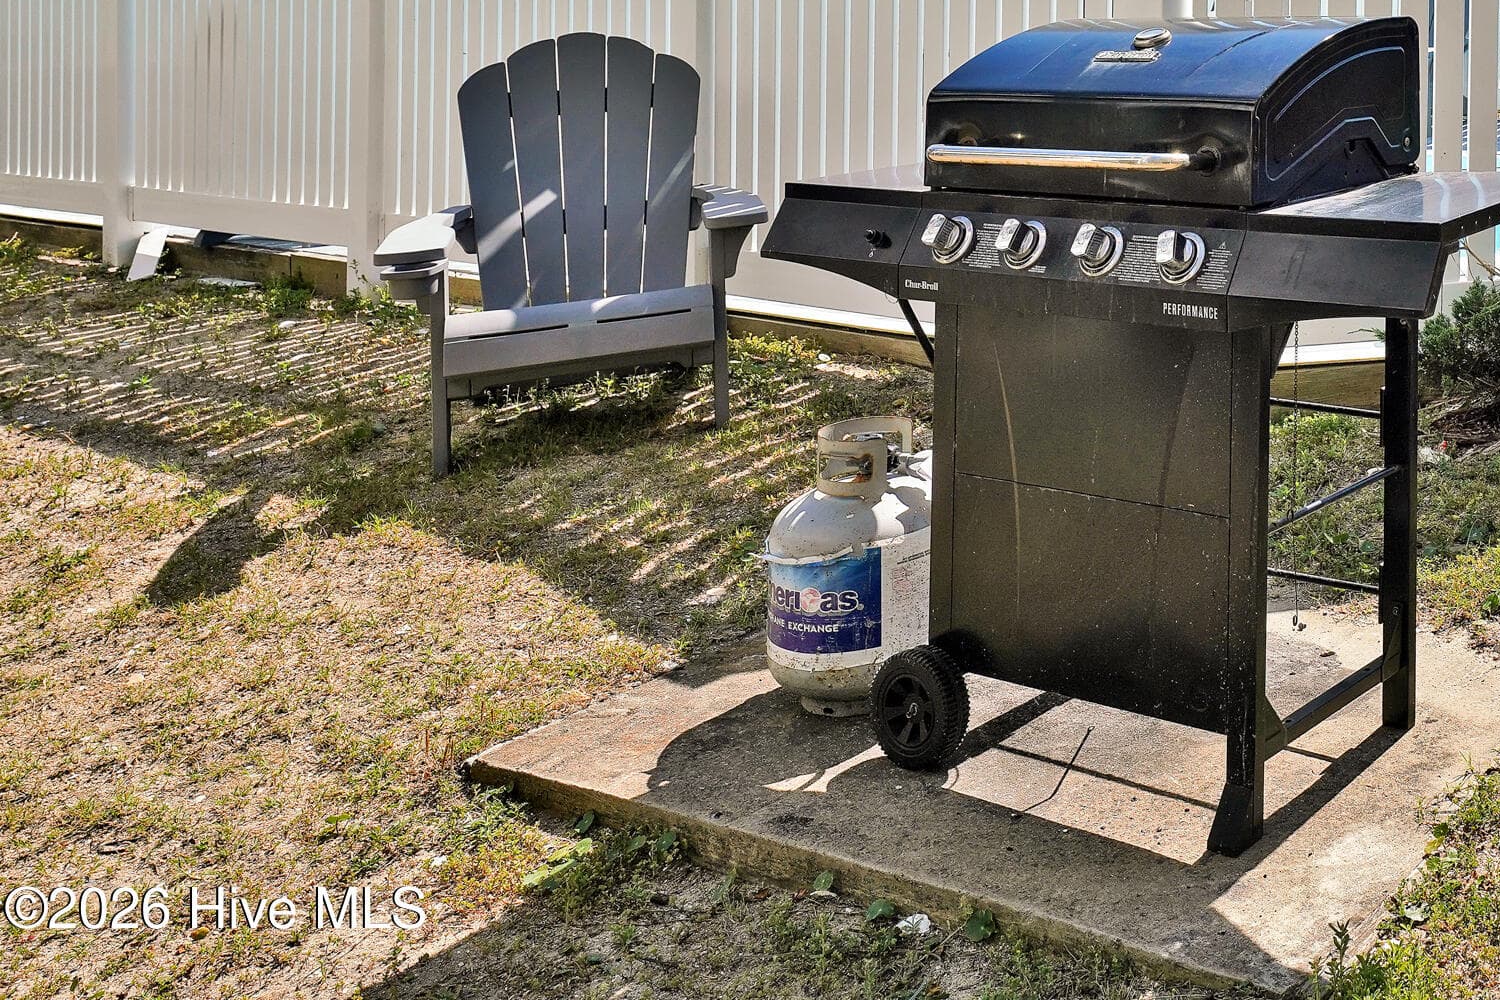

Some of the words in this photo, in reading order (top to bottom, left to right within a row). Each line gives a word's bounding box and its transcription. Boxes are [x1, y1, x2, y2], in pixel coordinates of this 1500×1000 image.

[904, 279, 939, 291] Char-Broil
[1162, 302, 1218, 320] PERFORMANCE
[788, 621, 840, 633] EXCHANGE
